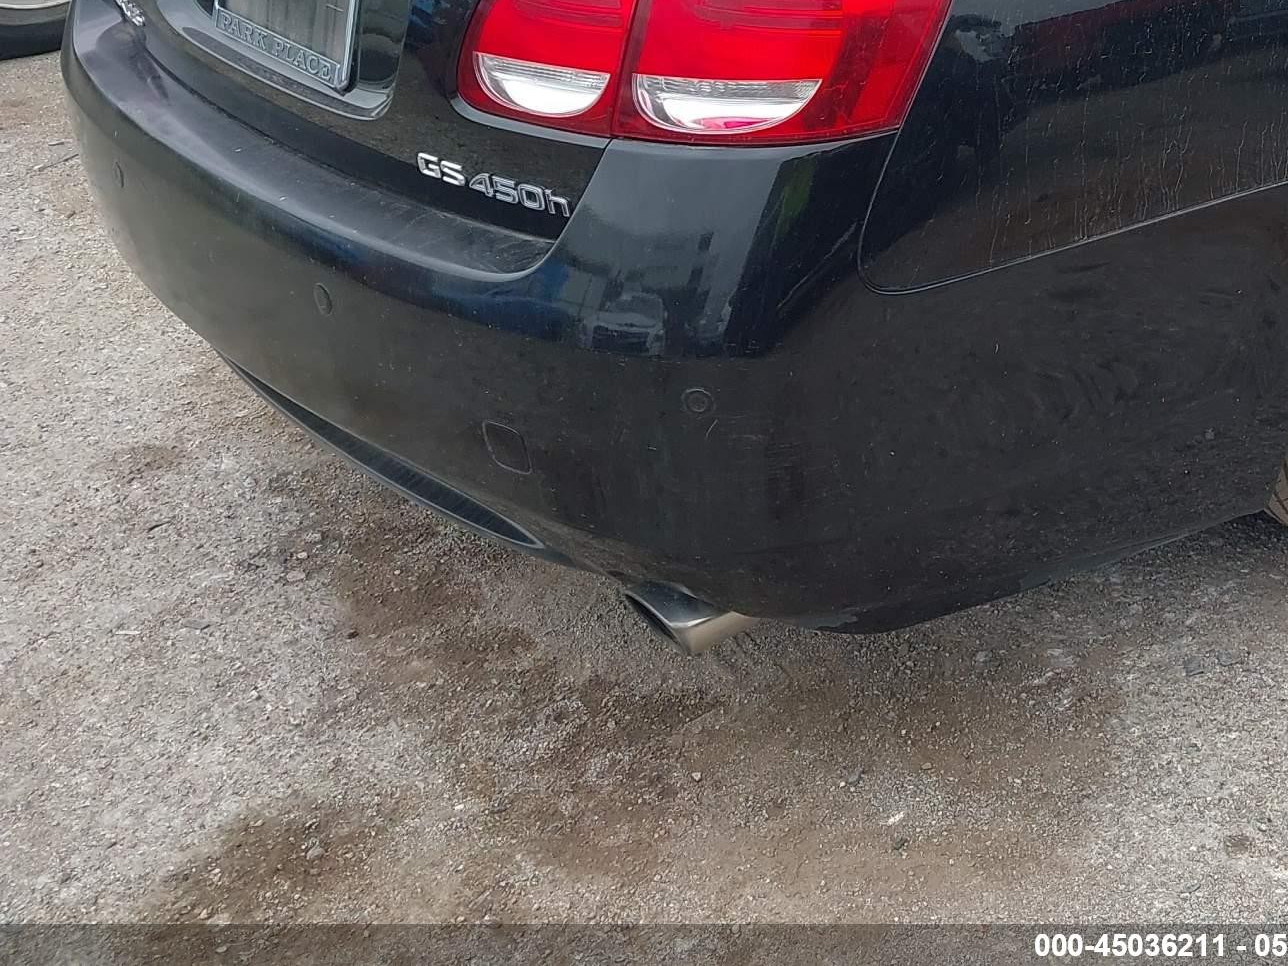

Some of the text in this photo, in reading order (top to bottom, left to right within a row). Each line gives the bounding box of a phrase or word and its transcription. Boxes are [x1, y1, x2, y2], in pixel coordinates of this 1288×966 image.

[221, 12, 332, 81] PARK PLACE
[416, 151, 570, 218] GS 450h
